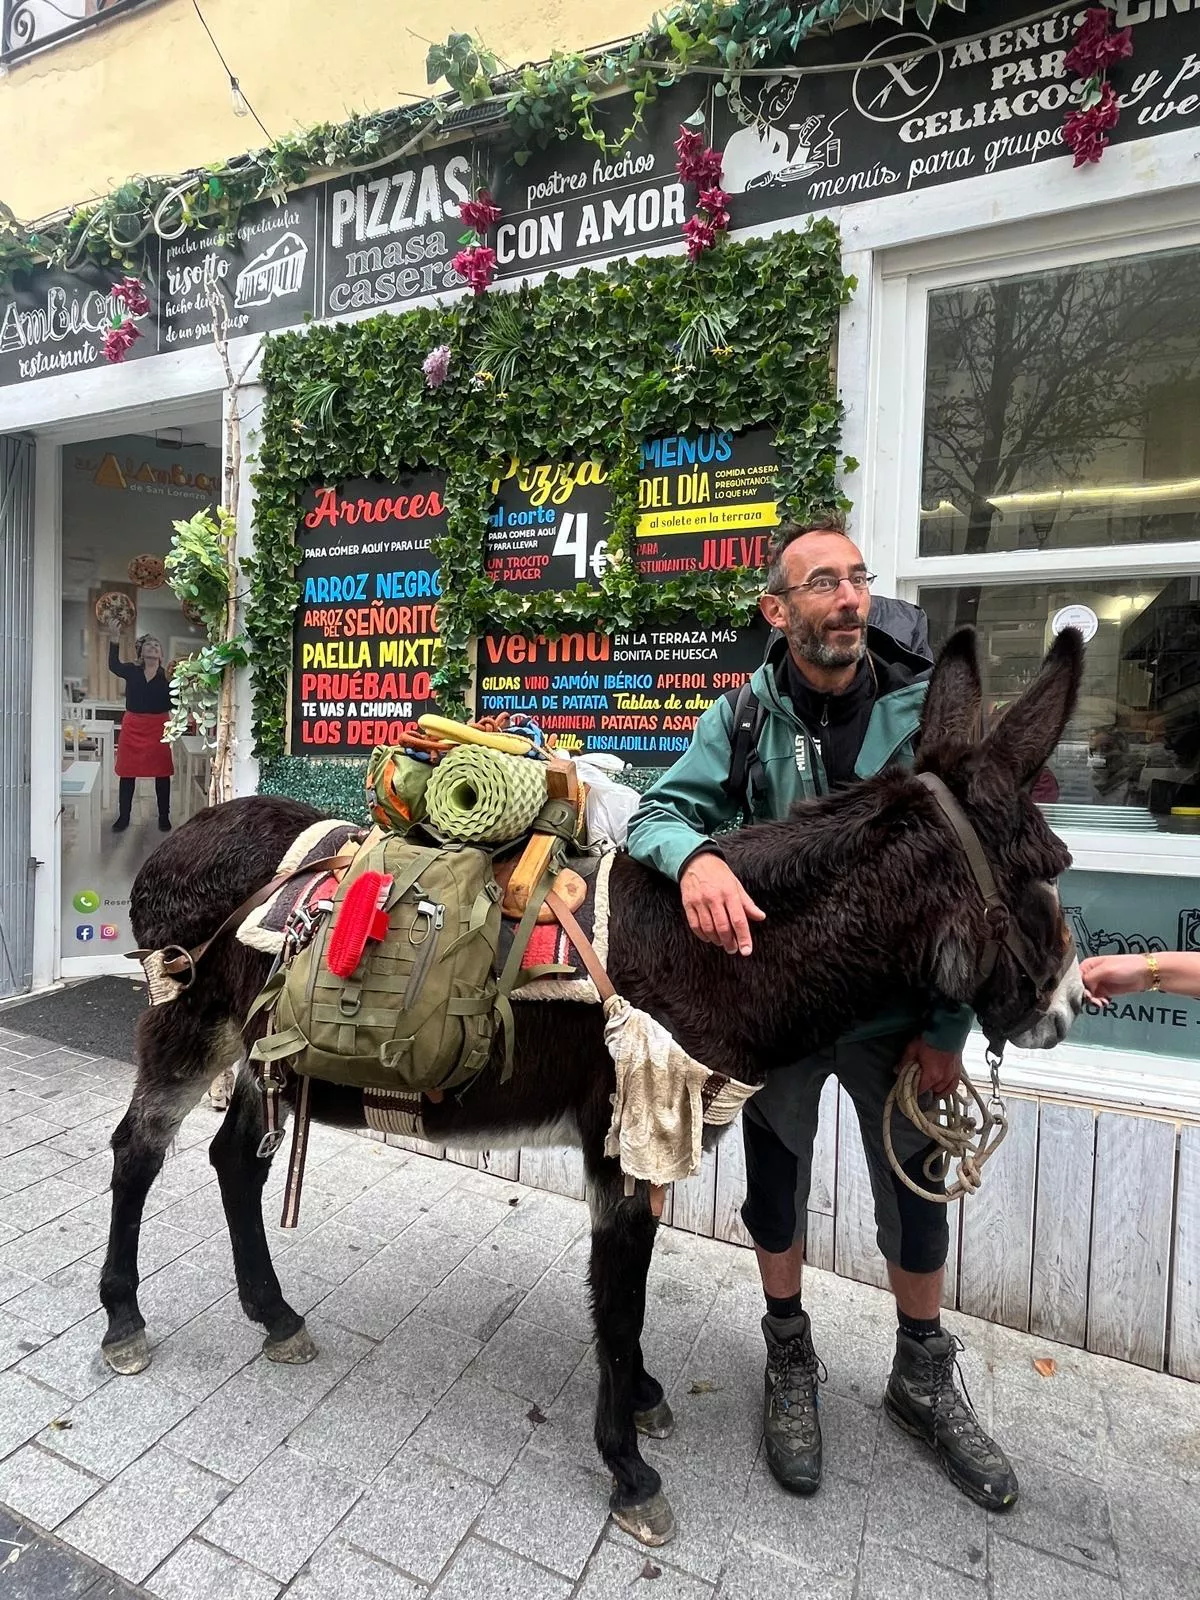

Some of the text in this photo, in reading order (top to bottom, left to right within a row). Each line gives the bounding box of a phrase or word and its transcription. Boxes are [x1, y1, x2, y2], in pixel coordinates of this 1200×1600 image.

[990, 50, 1067, 91] PAR
[1115, 69, 1163, 108] y
[807, 125, 1064, 200] menús para grupo
[527, 150, 656, 210] postres hechos
[332, 156, 471, 248] PIZZAS
[496, 182, 686, 264] CON AMOR
[345, 231, 448, 278] masa
[329, 259, 469, 312] casera
[165, 297, 193, 318] hecho
[165, 325, 178, 342] de
[179, 328, 194, 339] un
[18, 340, 98, 378] restaurante
[715, 465, 779, 478] COMIDA CASERA
[146, 485, 165, 495] San
[639, 464, 710, 509] DEL DÍA
[715, 488, 757, 499] LO QUE HAY
[304, 487, 445, 528] Arroces
[507, 506, 556, 526] corte
[650, 510, 762, 528] al solete en la terraza
[488, 526, 557, 541] PARA COMER AQUÍ
[305, 538, 432, 558] PARA COMER AQUÍ Y PARA LLE
[494, 541, 512, 551] PARA
[513, 540, 538, 550] LLEVAR
[488, 555, 549, 569] UN TROCITO
[504, 568, 541, 580] PLACER
[304, 570, 442, 603] ARROZ NEGRO
[304, 608, 344, 627] ARROZ
[323, 625, 340, 637] DEL
[614, 629, 738, 646] EN LA TERRAZA MÁS
[302, 641, 372, 670] PAELLA
[613, 648, 718, 661] BONITA DE HUESCA
[482, 676, 521, 690] GILDAS
[524, 676, 549, 690] VINO
[552, 671, 599, 690] JAMÓN
[604, 670, 653, 689] IBÉRICO
[656, 673, 708, 688] APEROL
[302, 702, 412, 717] TE VAS A CHUPAR
[482, 692, 720, 710] TORTILLA DE PATATA Tablas de ahu
[302, 720, 342, 744] LOS
[542, 715, 596, 729] MARINERA
[601, 715, 658, 730] PATATAS
[586, 735, 657, 751] ENSALADILLA
[659, 736, 689, 751] RUSA
[795, 734, 806, 771] MILLET
